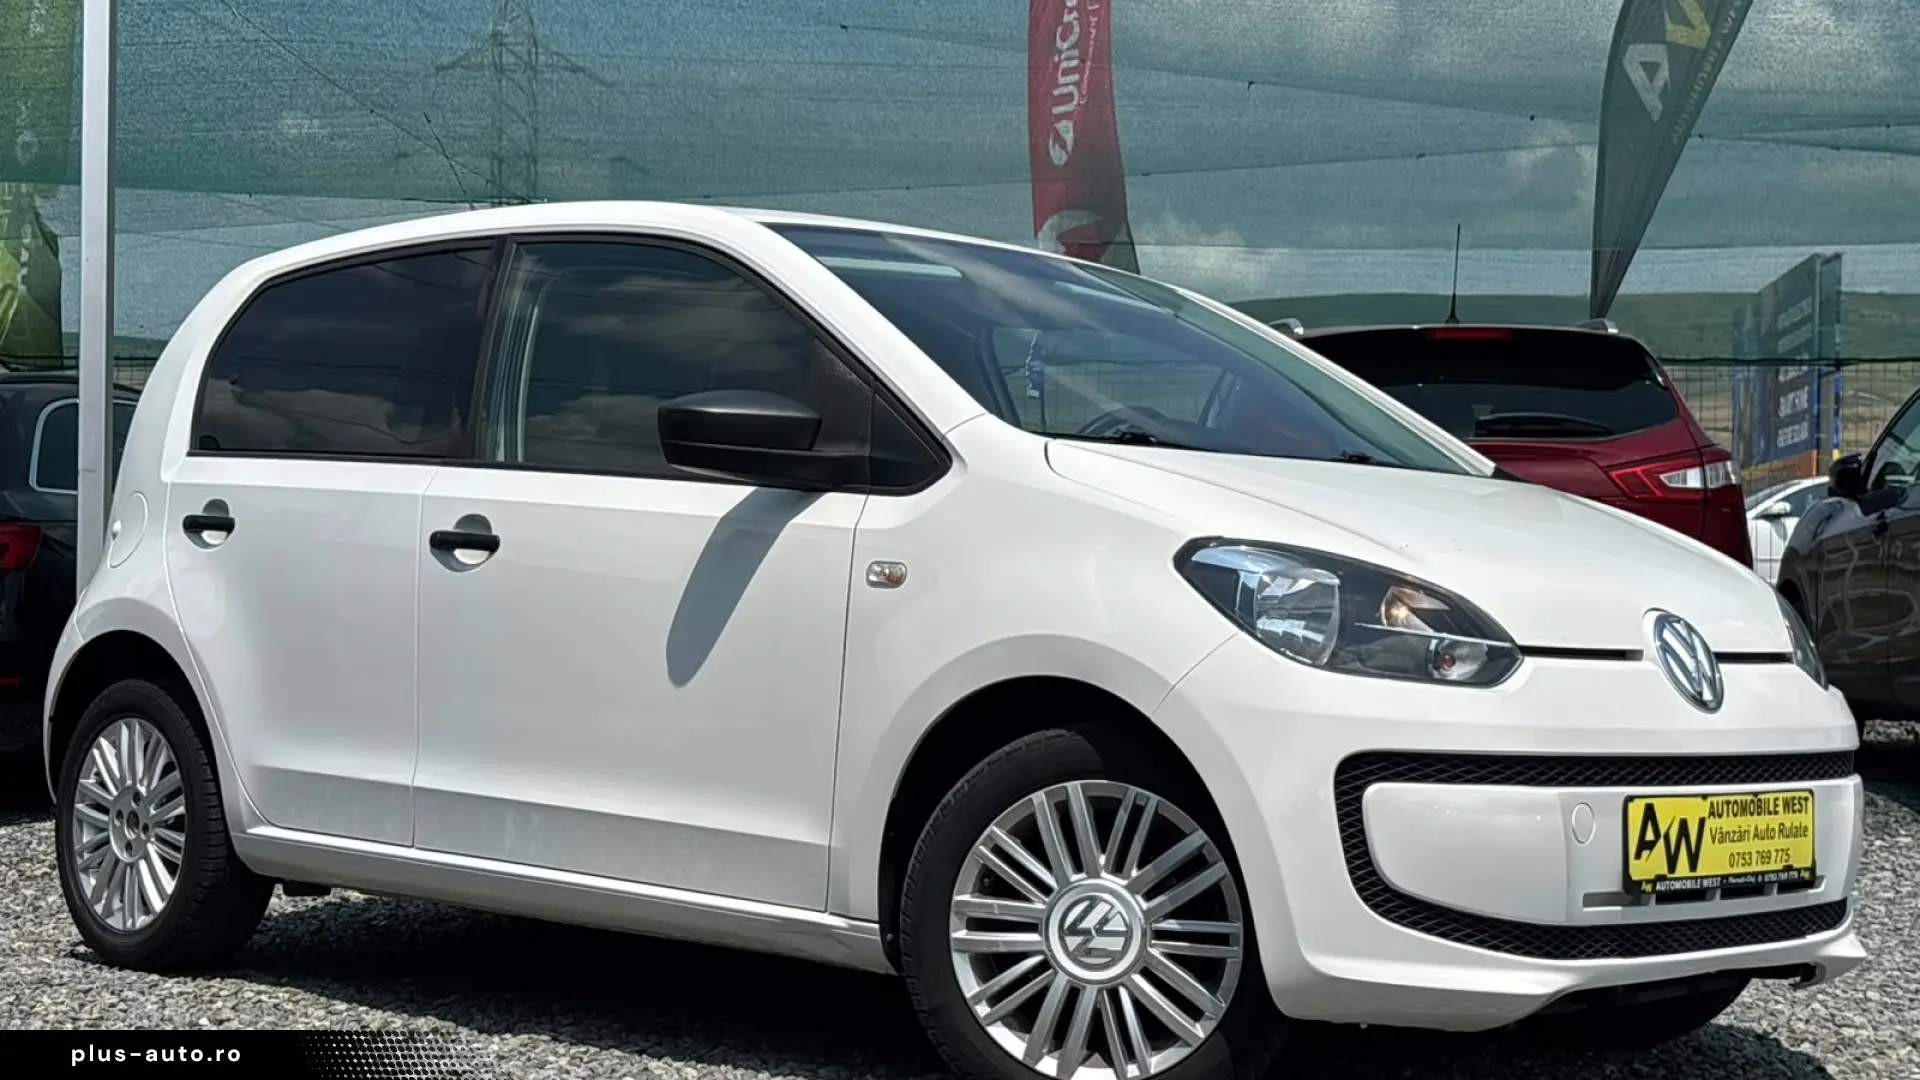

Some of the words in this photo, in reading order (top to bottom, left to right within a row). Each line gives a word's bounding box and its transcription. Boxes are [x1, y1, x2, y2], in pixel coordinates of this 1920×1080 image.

[1708, 797, 1779, 819] AUTOMOBILE
[1782, 796, 1809, 815] WEST
[1752, 823, 1776, 842] Auto
[1778, 821, 1809, 840] Rulate
[1728, 851, 1753, 868] 0753
[1755, 849, 1771, 866] 769
[1774, 848, 1790, 864] 775
[1656, 879, 1700, 891] AUTOMOBILE
[1702, 877, 1720, 888] WEST
